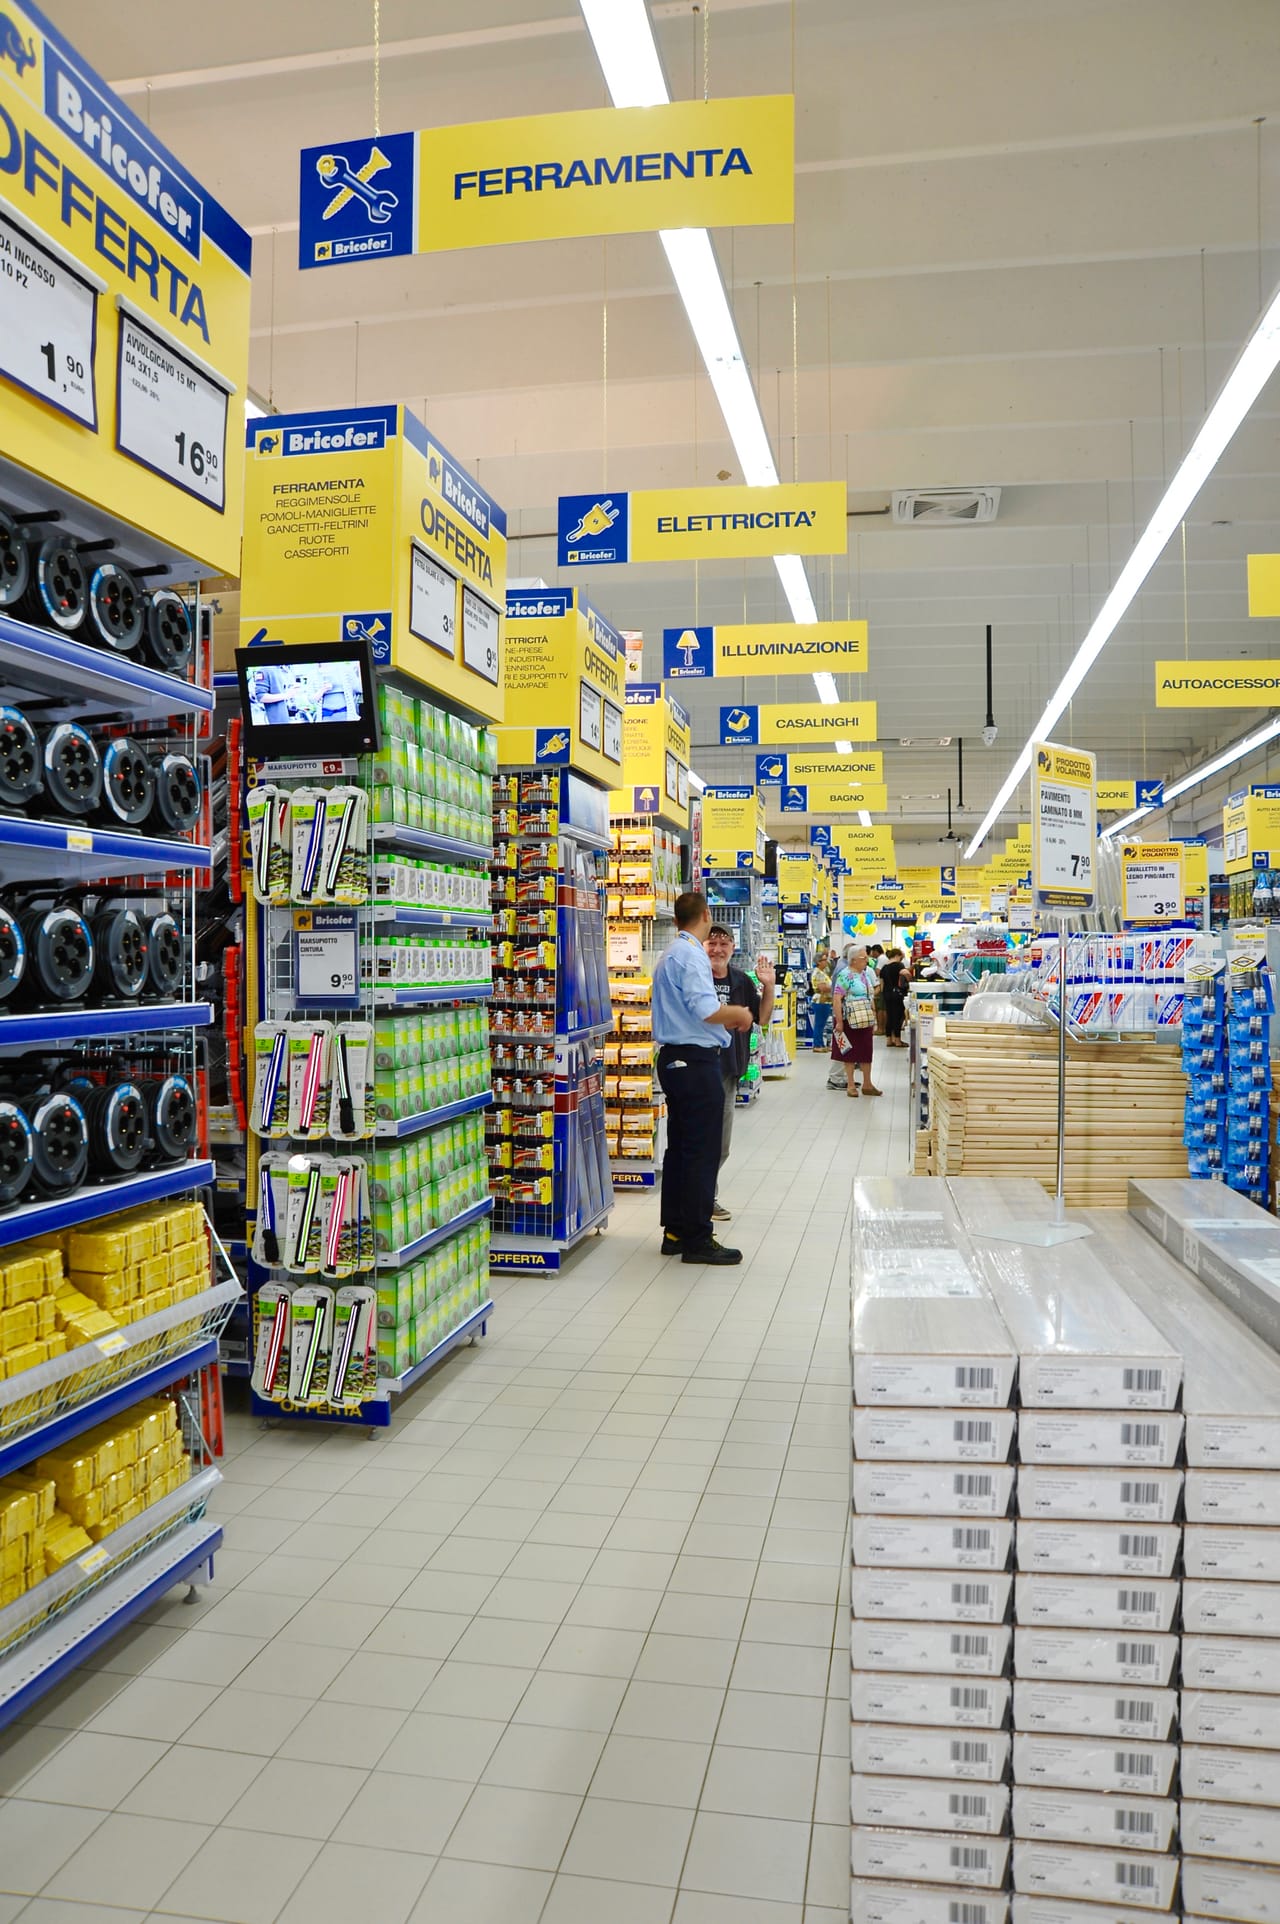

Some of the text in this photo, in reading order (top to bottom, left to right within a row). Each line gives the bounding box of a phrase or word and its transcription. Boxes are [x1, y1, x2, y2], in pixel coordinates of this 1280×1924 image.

[57, 71, 192, 239] Bricofer
[453, 147, 753, 201] FERRAMENTA
[334, 236, 388, 257] Bricofer
[1, 258, 29, 289] 10 PZ
[15, 245, 56, 288] INCASSO
[125, 351, 159, 384] DA 3X1,5
[126, 333, 174, 377] AVVOLGICAVO
[176, 370, 185, 385] 15
[186, 377, 197, 392] MT
[289, 426, 378, 452] Bricofer
[273, 478, 365, 495] FERRAMENTA
[275, 493, 361, 509] REGGIMENSOLE
[444, 469, 488, 531] Bricofer
[260, 505, 377, 523] POMOLI-MANIGLIETTE
[266, 519, 369, 535] GANCETTI-FELTRINI
[298, 534, 336, 546] RUOTE
[420, 498, 493, 587] OFFERTA
[283, 546, 350, 560] CASSEFORTI
[579, 551, 613, 560] Bricofer
[595, 621, 616, 656] Bricofer
[722, 640, 860, 657] ILLUMINAZIONE
[509, 655, 554, 663] INDUSTRIALI
[519, 672, 557, 680] SUPPORTI
[558, 671, 568, 679] TV
[585, 646, 619, 696] OFFERTA
[1162, 678, 1280, 690] AUTOACCESSOR
[625, 692, 652, 704] ofer
[776, 717, 859, 729] CASALINGHI
[267, 762, 318, 771] MARSUPIOTTO
[794, 763, 876, 774] SISTEMAZIONE
[1056, 757, 1090, 771] PRODOTTO
[1056, 765, 1091, 779] VOLANTINO
[717, 791, 748, 799] Bricofer
[1041, 790, 1071, 804] PAVIMENTO
[1266, 790, 1280, 798] Bri
[1041, 804, 1068, 817] LAMINATO
[315, 915, 353, 925] Bricofer
[612, 1174, 644, 1183] FERTA
[488, 1253, 546, 1265] OFFERTA
